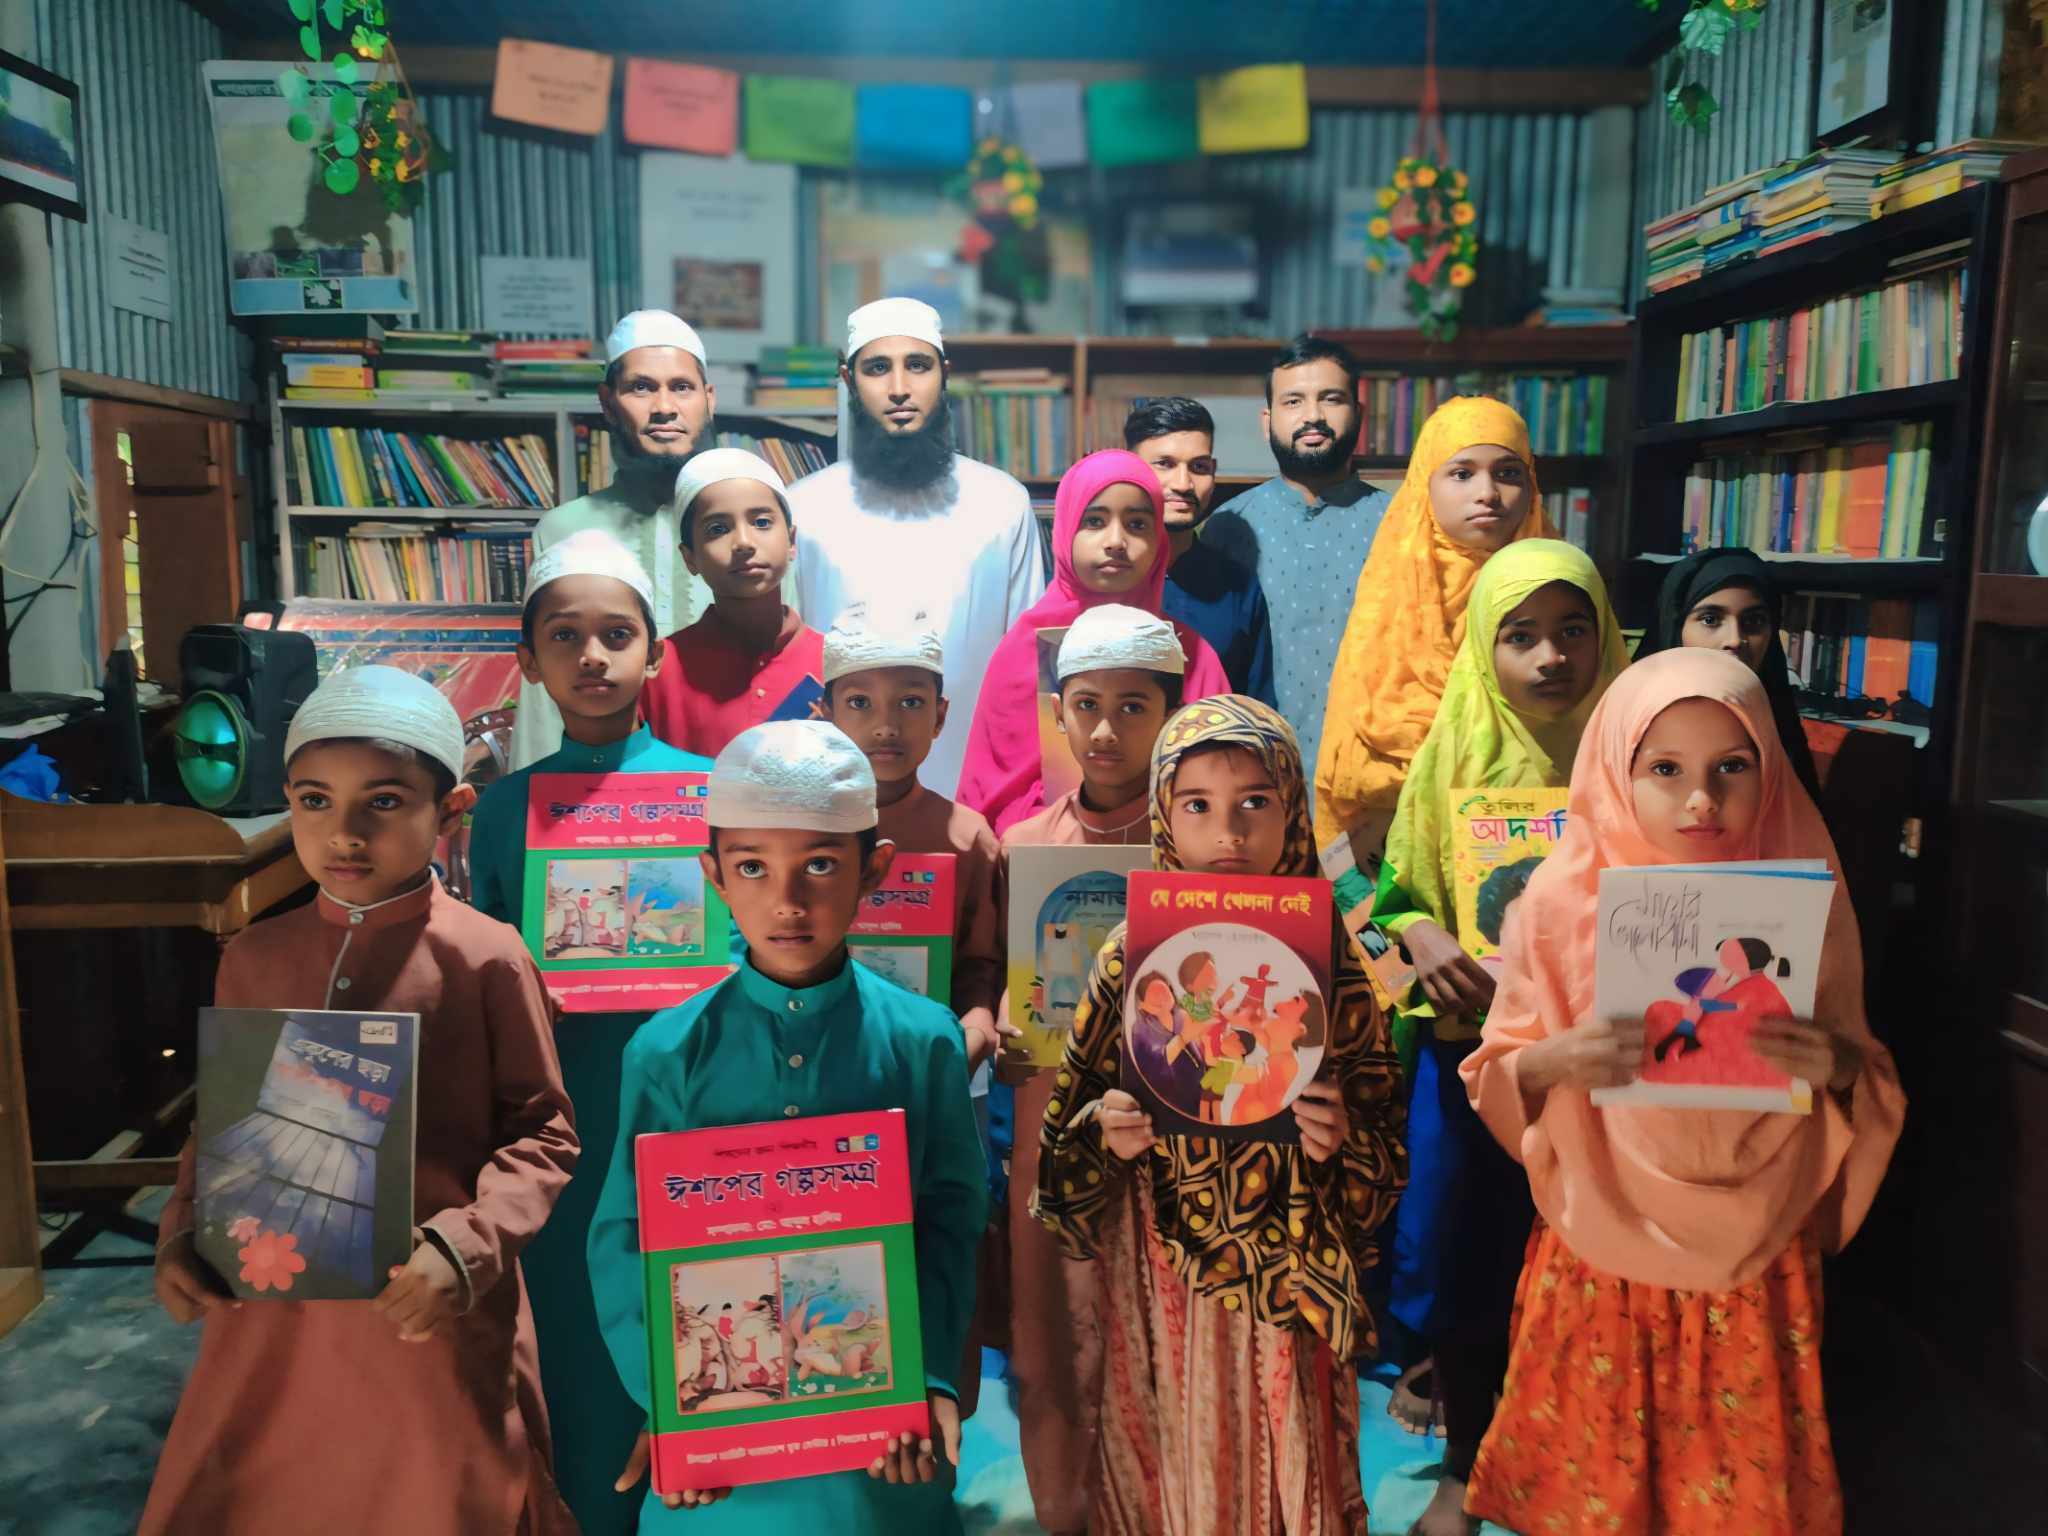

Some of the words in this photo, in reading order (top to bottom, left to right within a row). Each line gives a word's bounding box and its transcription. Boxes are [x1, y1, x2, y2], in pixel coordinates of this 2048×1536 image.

[1151, 889, 1170, 908] যে
[663, 1171, 766, 1208] ঈশপের
[774, 1155, 881, 1198] গল্পসমগ্র
